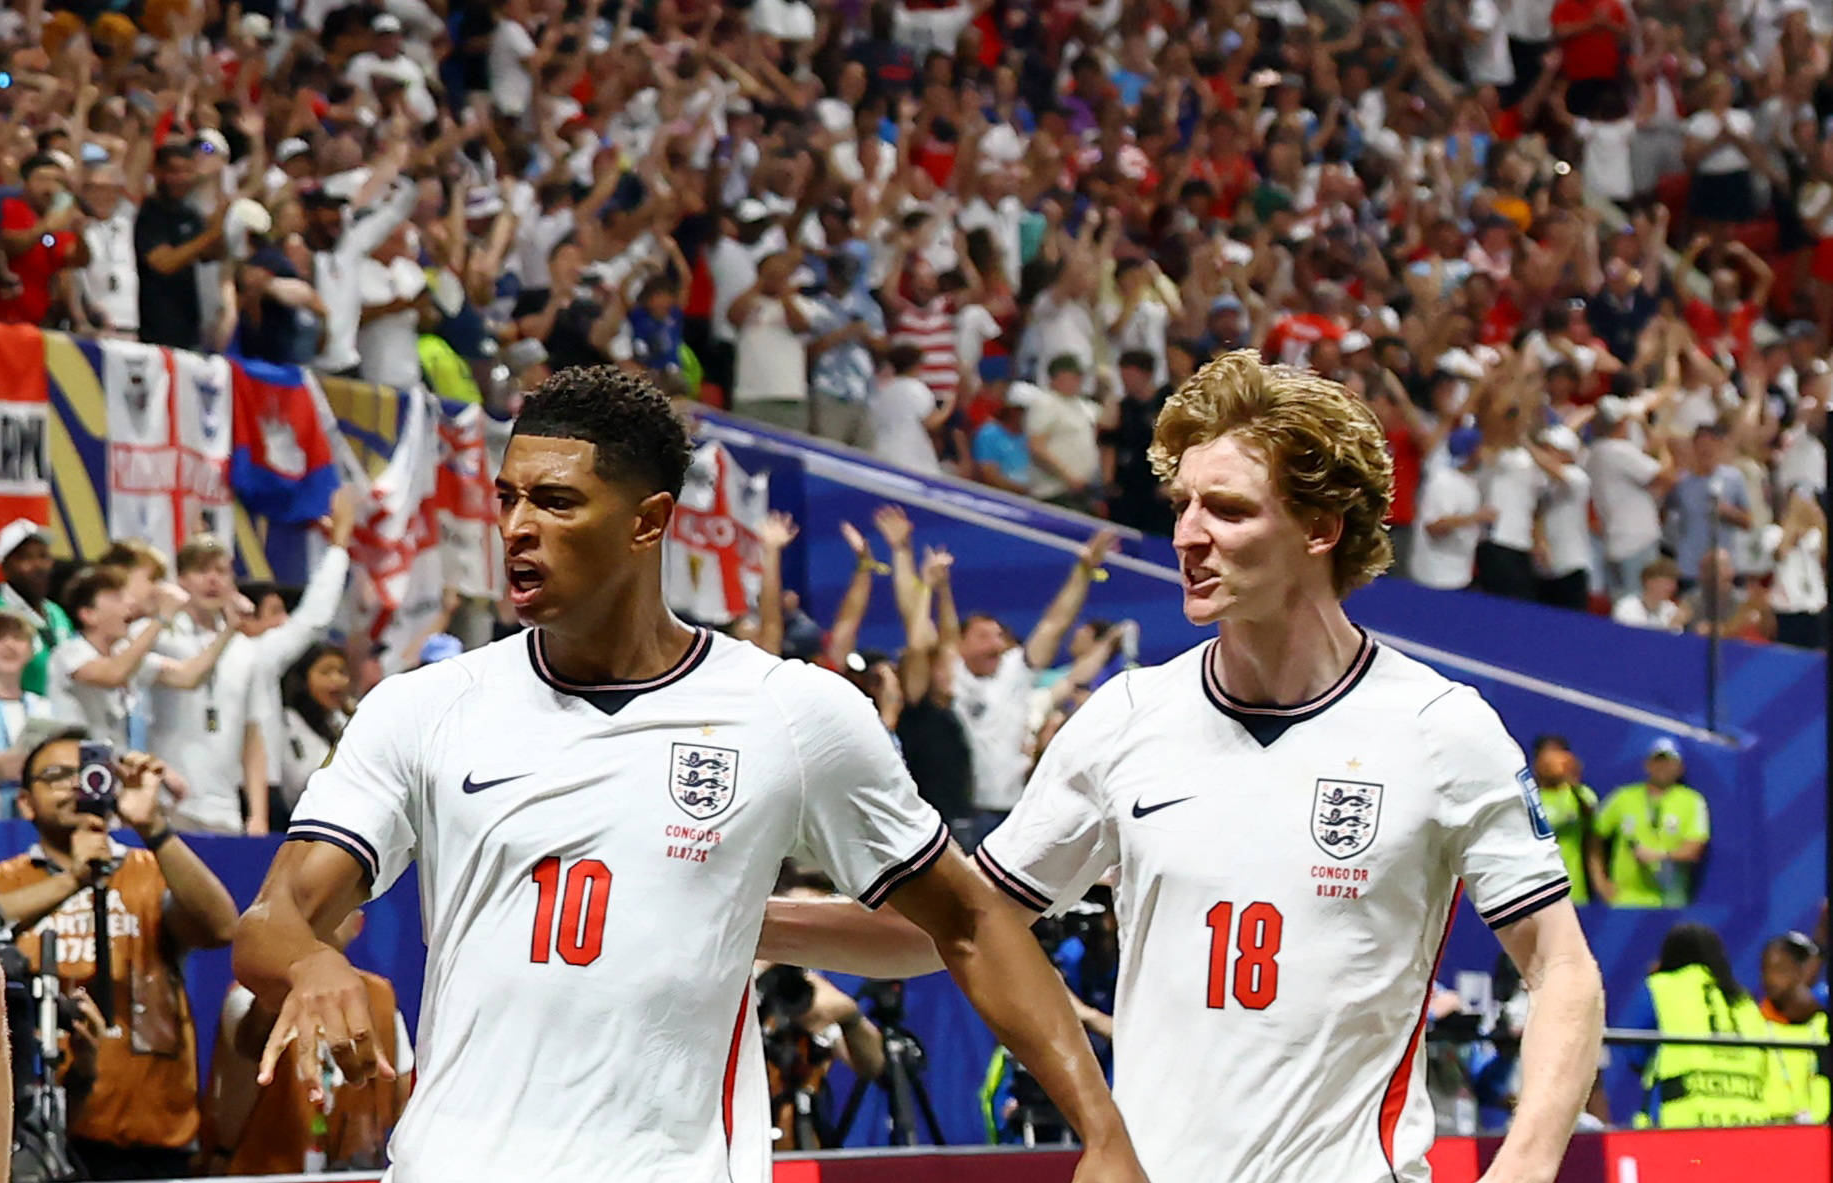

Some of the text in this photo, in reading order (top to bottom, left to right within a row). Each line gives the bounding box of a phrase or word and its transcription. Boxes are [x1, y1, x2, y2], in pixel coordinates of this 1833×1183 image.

[665, 824, 705, 842] CONGO
[1310, 865, 1369, 881] CONGO DR
[530, 855, 613, 967] 10
[1206, 901, 1284, 1011] 18
